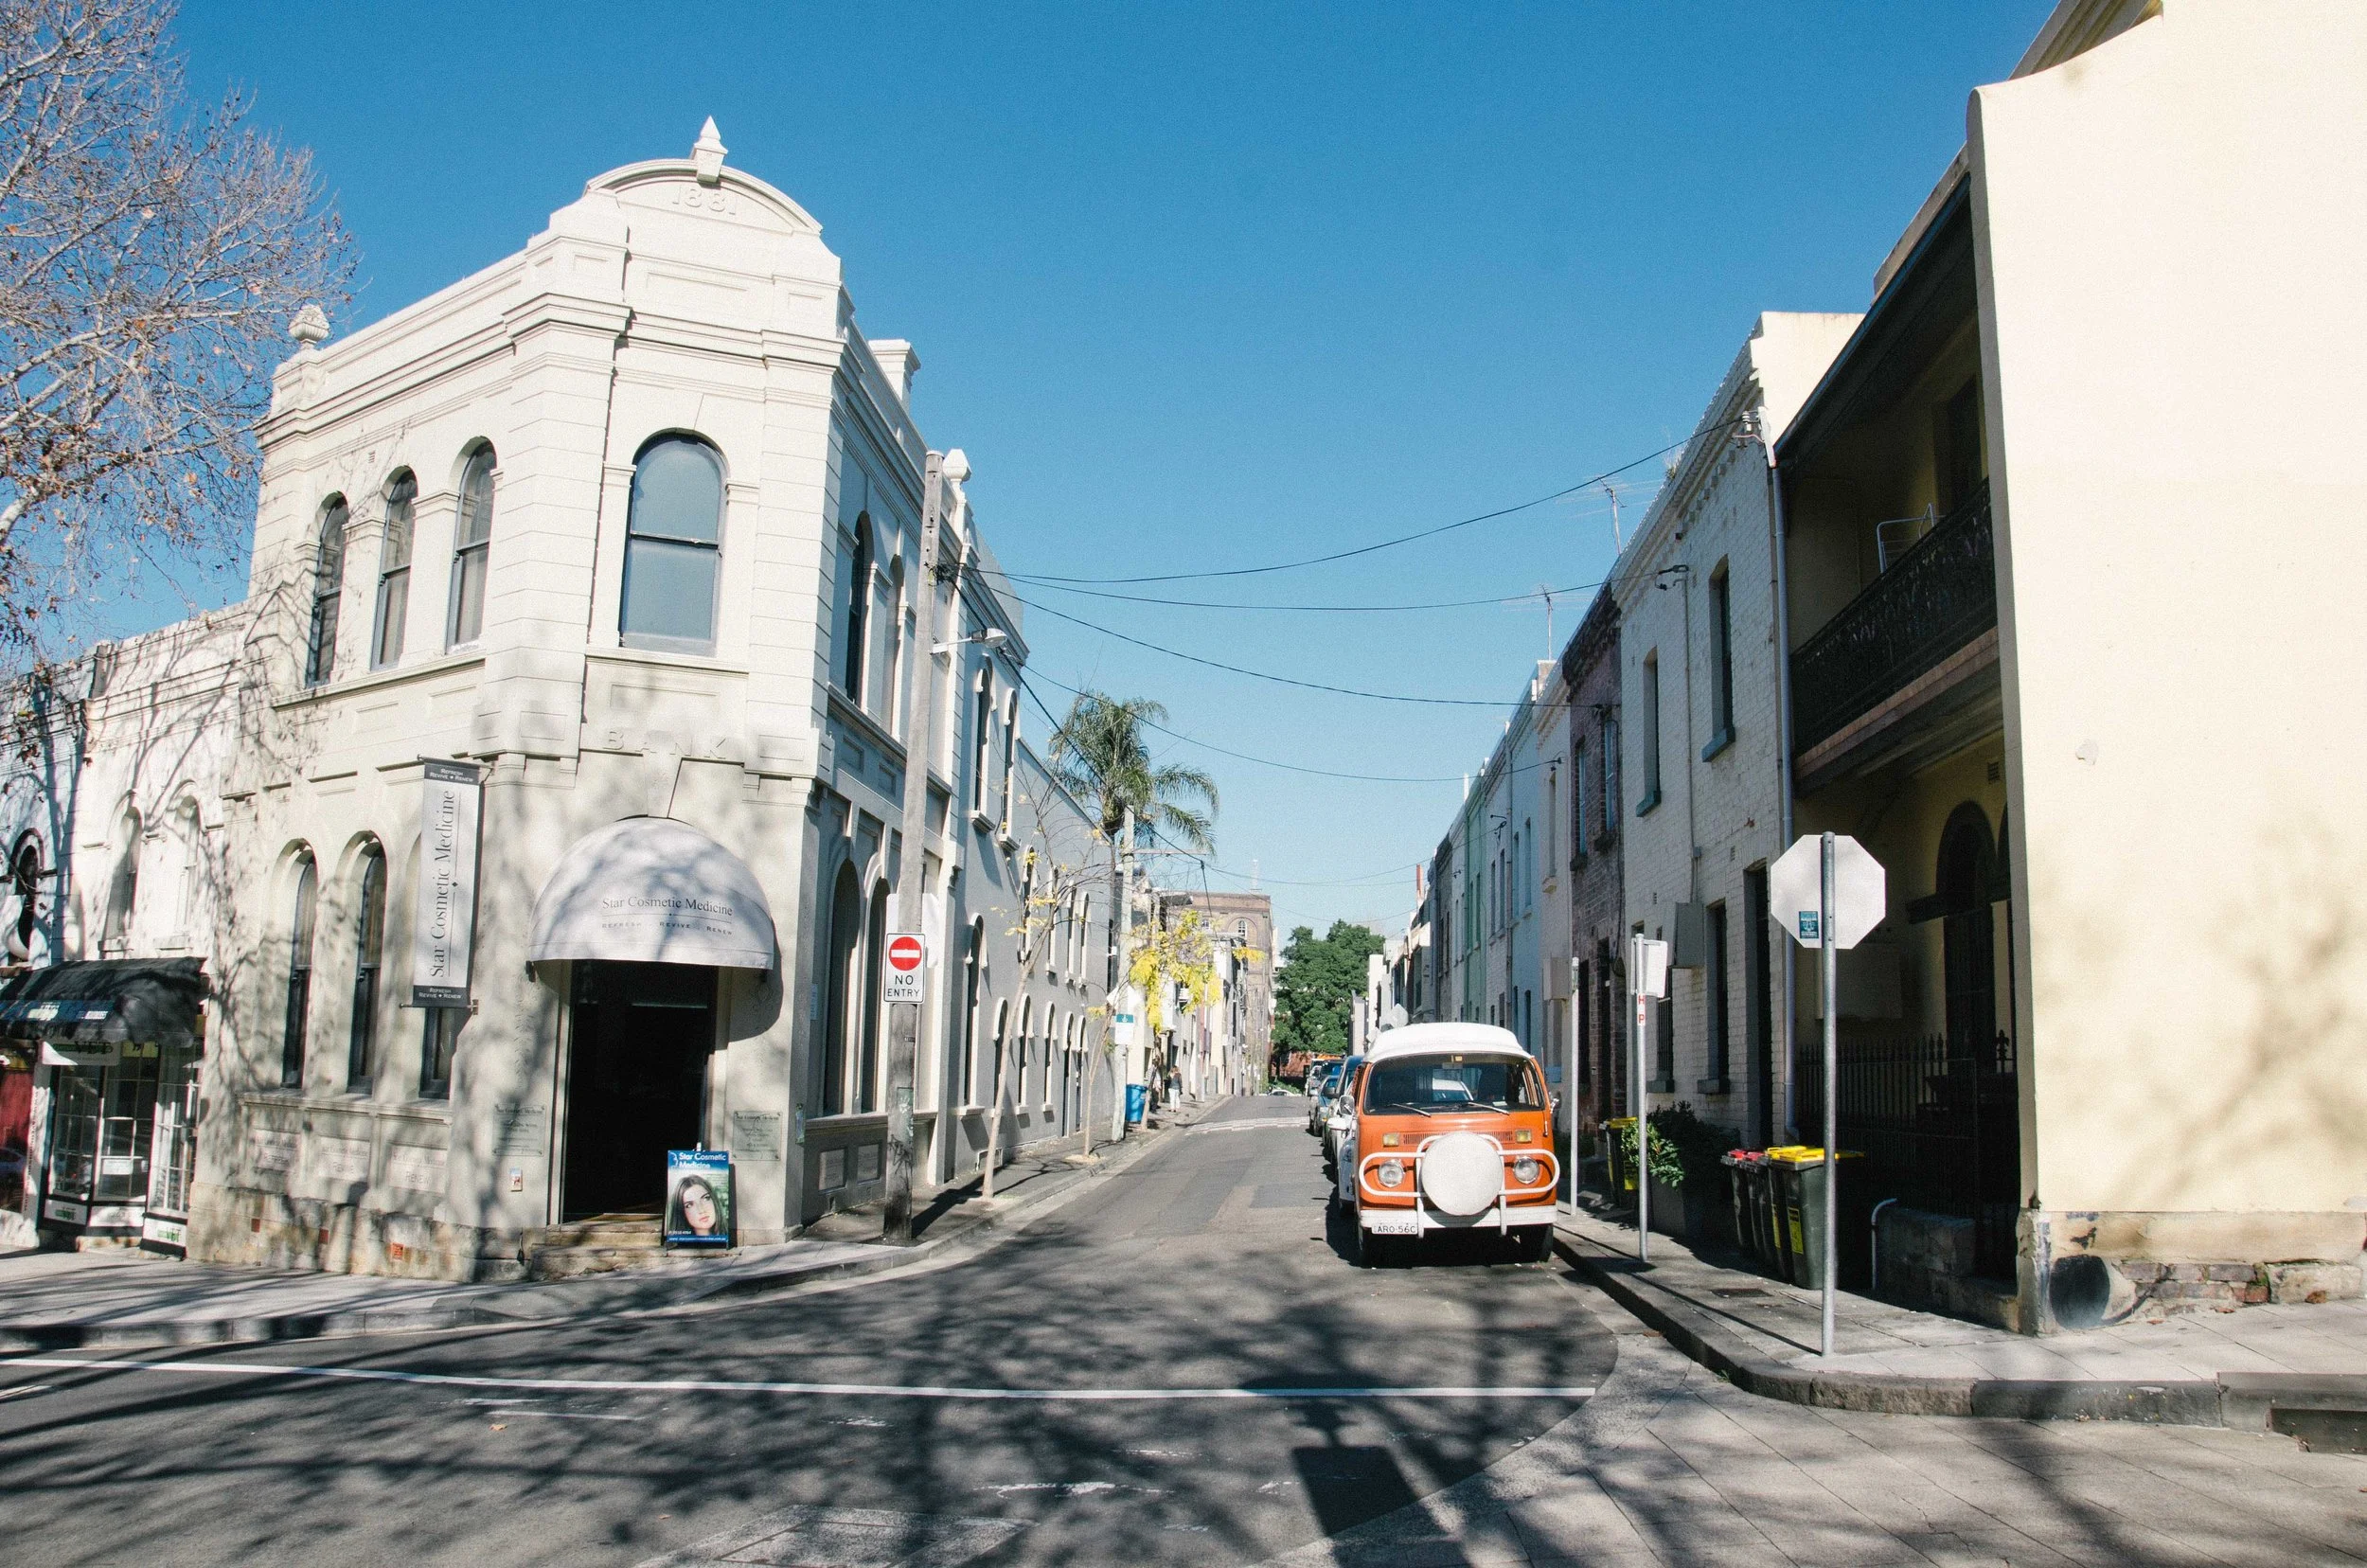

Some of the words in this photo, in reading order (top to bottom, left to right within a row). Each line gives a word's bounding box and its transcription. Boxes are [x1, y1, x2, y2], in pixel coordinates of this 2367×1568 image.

[602, 730, 727, 759] BANK
[435, 791, 455, 863] Medicine
[431, 867, 450, 939] Cosmetic
[602, 898, 624, 909] Star
[628, 897, 682, 909] Cosmetic
[685, 898, 733, 917] Medicine
[706, 926, 733, 935] RENEW
[430, 945, 445, 978] Star
[895, 974, 914, 986] NO
[887, 989, 920, 997] ENTRY
[679, 1151, 693, 1161] Star
[694, 1152, 727, 1161] Cosmetic
